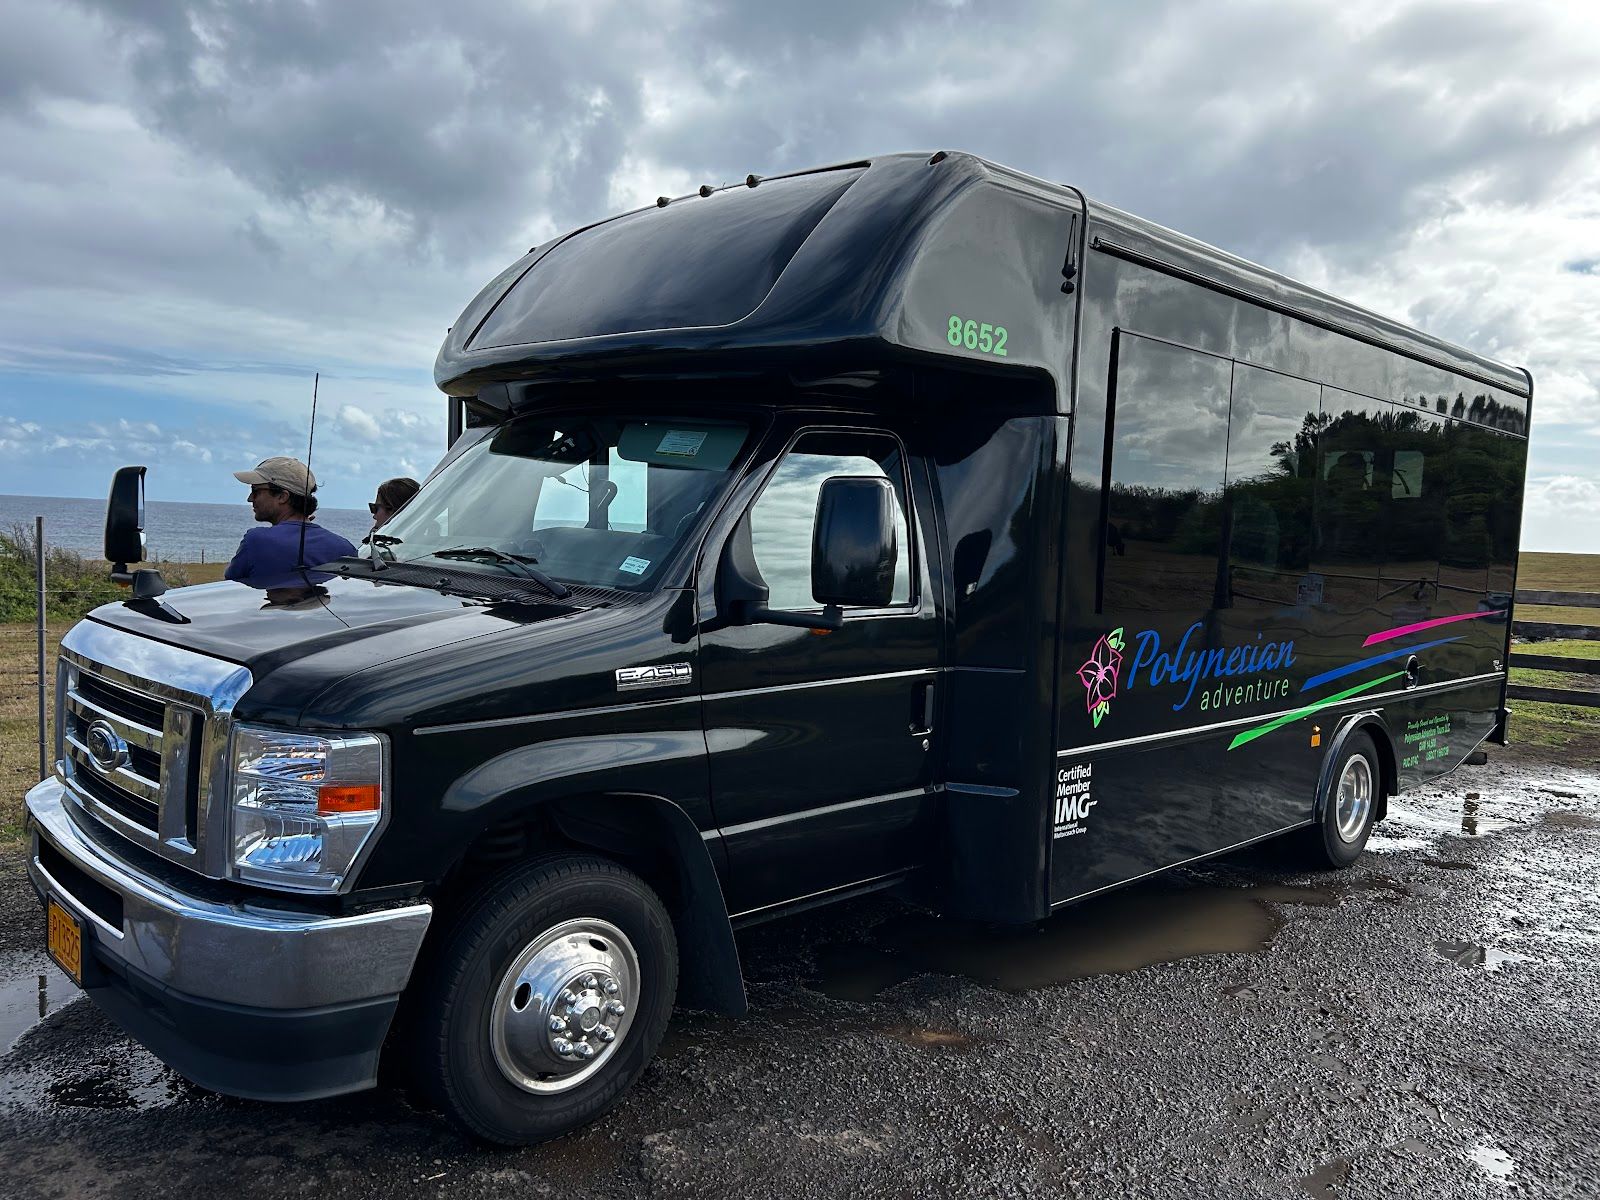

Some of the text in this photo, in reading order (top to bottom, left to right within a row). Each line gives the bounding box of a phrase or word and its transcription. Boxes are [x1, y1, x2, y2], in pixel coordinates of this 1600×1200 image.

[947, 315, 1008, 357] 8652
[1126, 621, 1297, 711] Polynesian
[1200, 677, 1289, 711] adventure
[1056, 779, 1092, 797] Member
[1058, 762, 1092, 782] Certified
[1054, 792, 1091, 825] IMG
